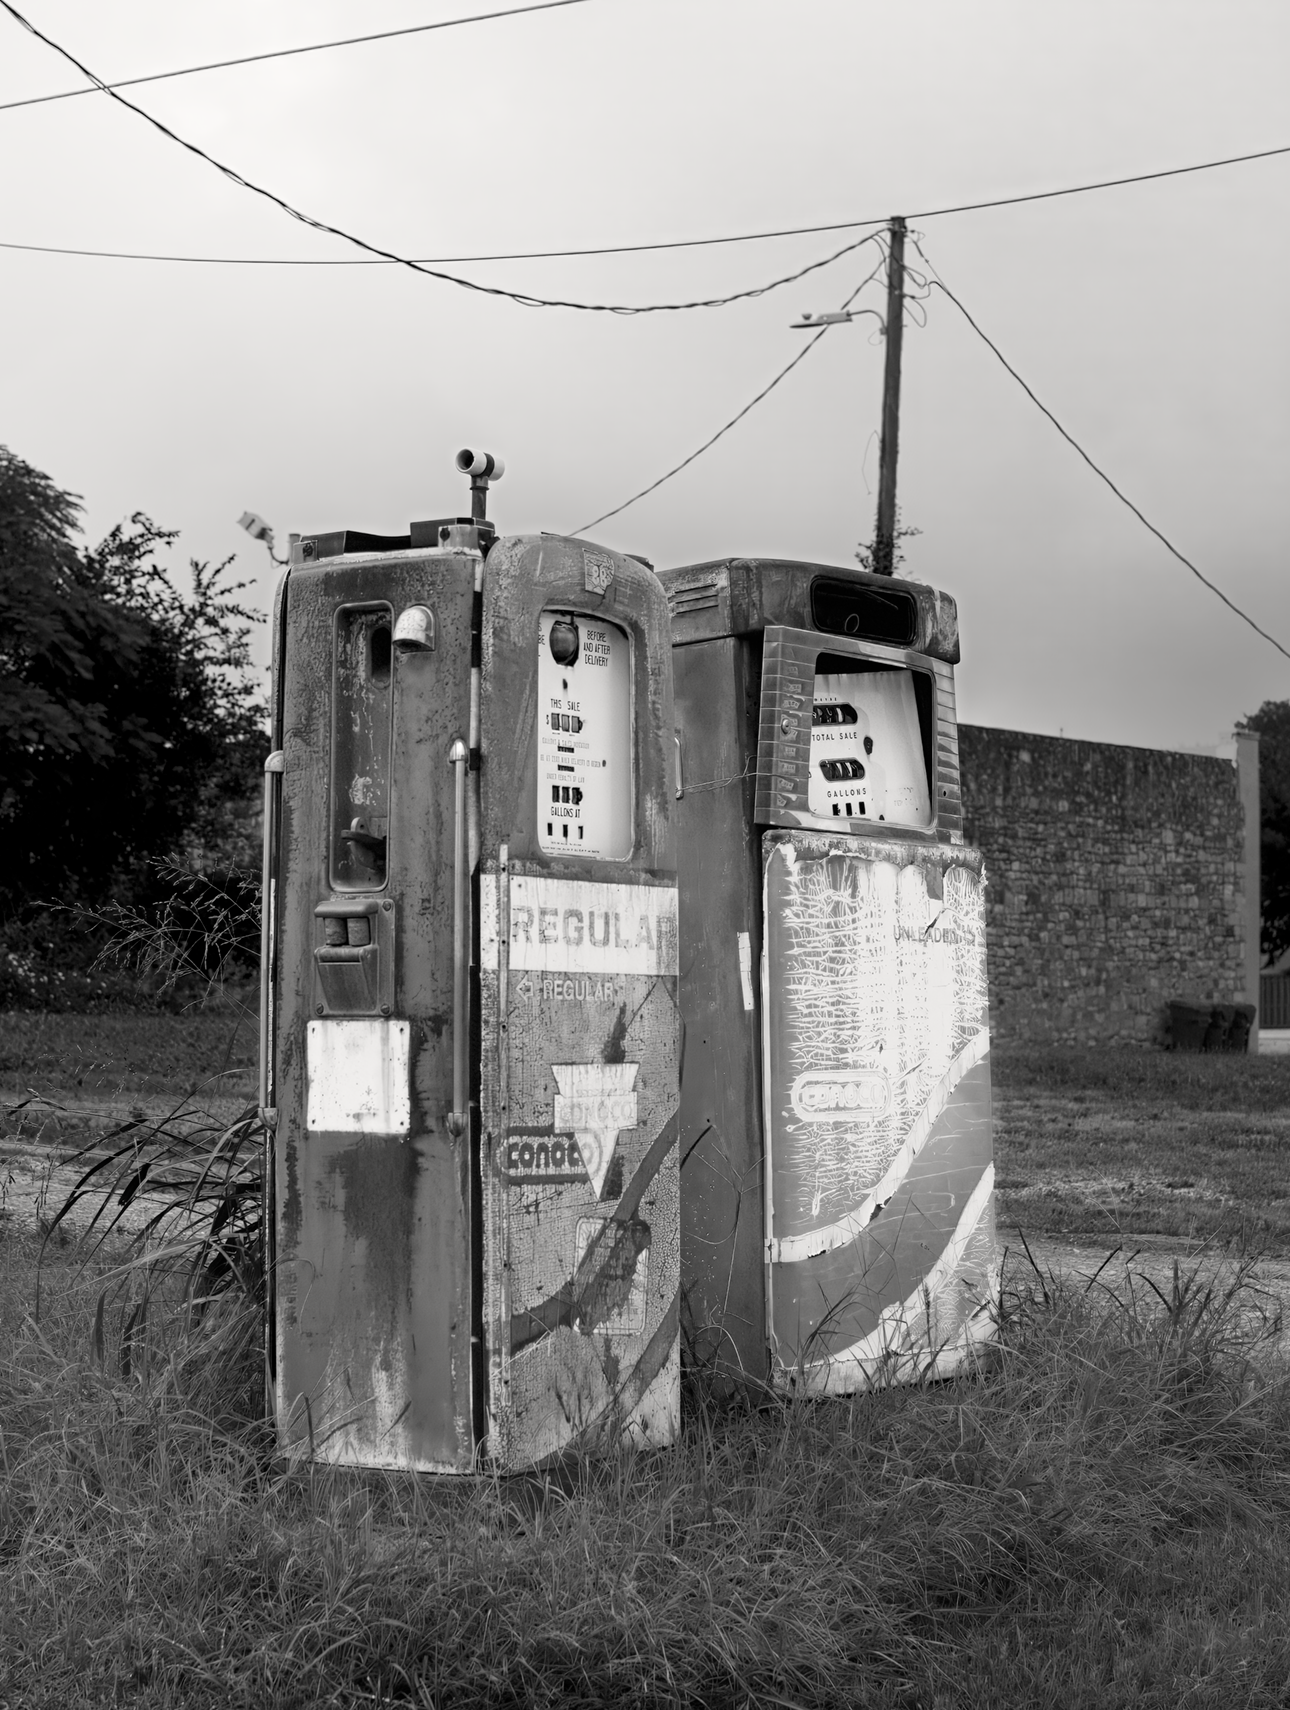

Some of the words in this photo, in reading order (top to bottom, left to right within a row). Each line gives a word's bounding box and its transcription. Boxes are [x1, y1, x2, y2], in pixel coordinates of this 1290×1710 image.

[587, 630, 606, 642] BEFORE
[583, 642, 594, 653] AND
[595, 644, 610, 655] AFTER
[550, 699, 562, 709] THIS
[567, 701, 580, 712] SALE
[812, 733, 835, 742] TOTAL
[839, 732, 858, 740] SALE
[827, 787, 867, 798] GALLONS
[550, 806, 574, 818] GALLONS
[575, 808, 581, 818] AT
[511, 905, 677, 952] REGULAR
[543, 979, 614, 1001] REGULAR
